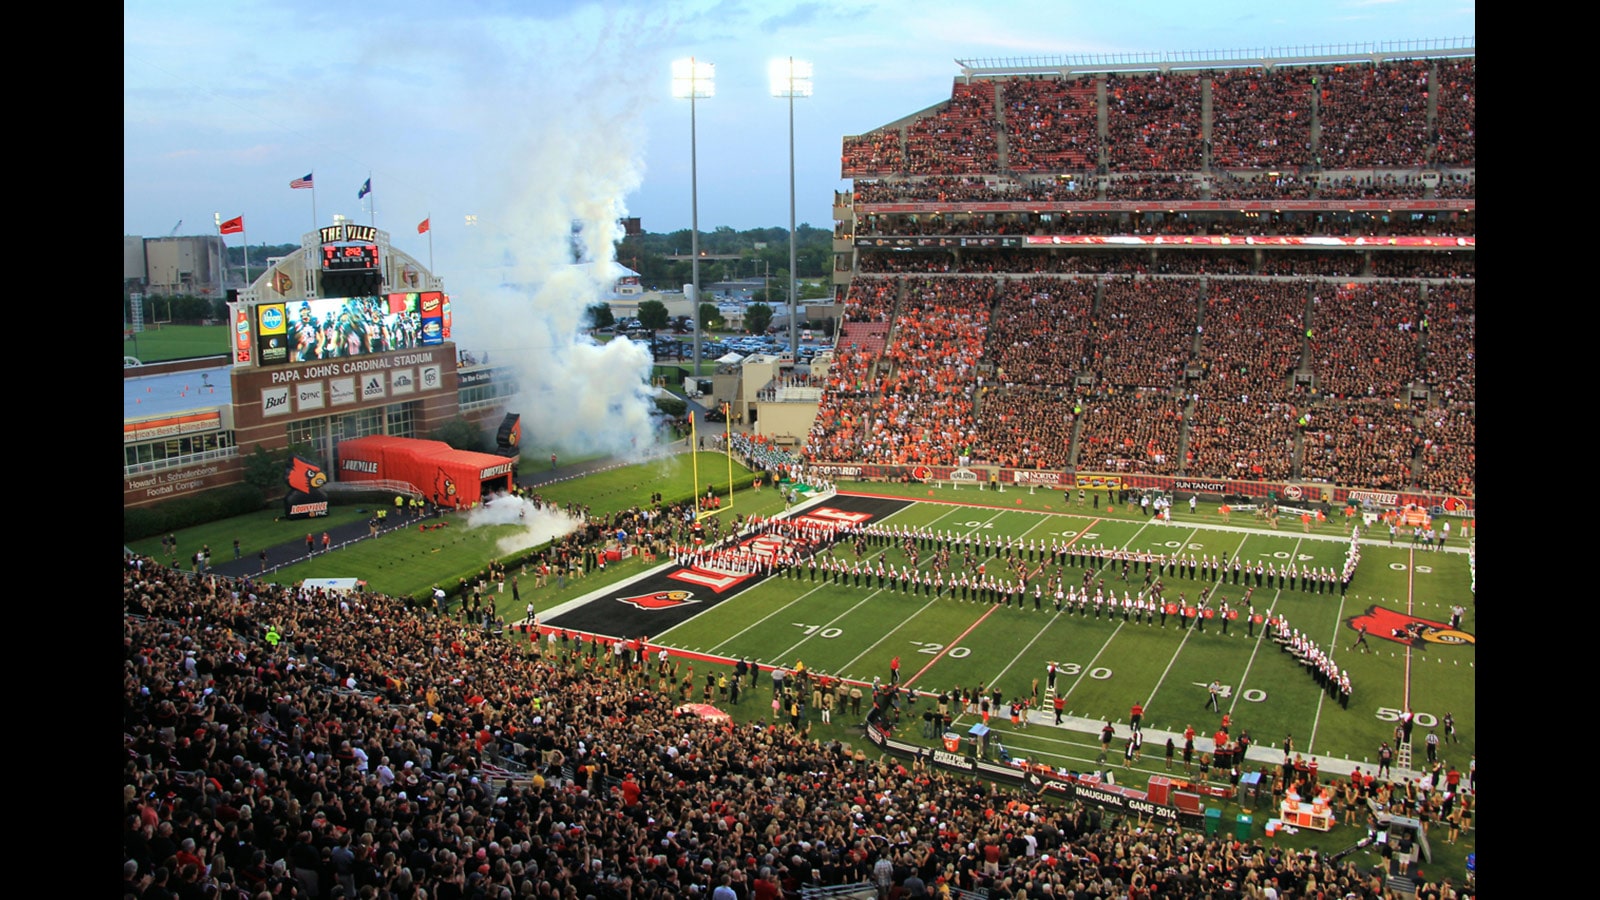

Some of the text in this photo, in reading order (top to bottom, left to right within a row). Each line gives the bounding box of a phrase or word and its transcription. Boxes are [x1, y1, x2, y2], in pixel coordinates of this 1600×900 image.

[322, 225, 376, 242] THE VILLE
[272, 352, 433, 383] PAPA JOHN'S CARDINAL STADIUM
[308, 391, 320, 399] PNC
[364, 388, 383, 396] adidas
[265, 393, 287, 409] Bud
[480, 462, 512, 479] LOUISVILLE
[1030, 471, 1060, 480] NORTON
[129, 478, 157, 489] Howard
[147, 479, 204, 496] Football Complex
[1207, 483, 1225, 491] CITY
[1349, 490, 1398, 504] LOUISVILLE
[290, 501, 328, 514] LOUISVILLE
[1044, 780, 1067, 791] ACC
[1075, 786, 1177, 819] INAUGURAL GAME 2014
